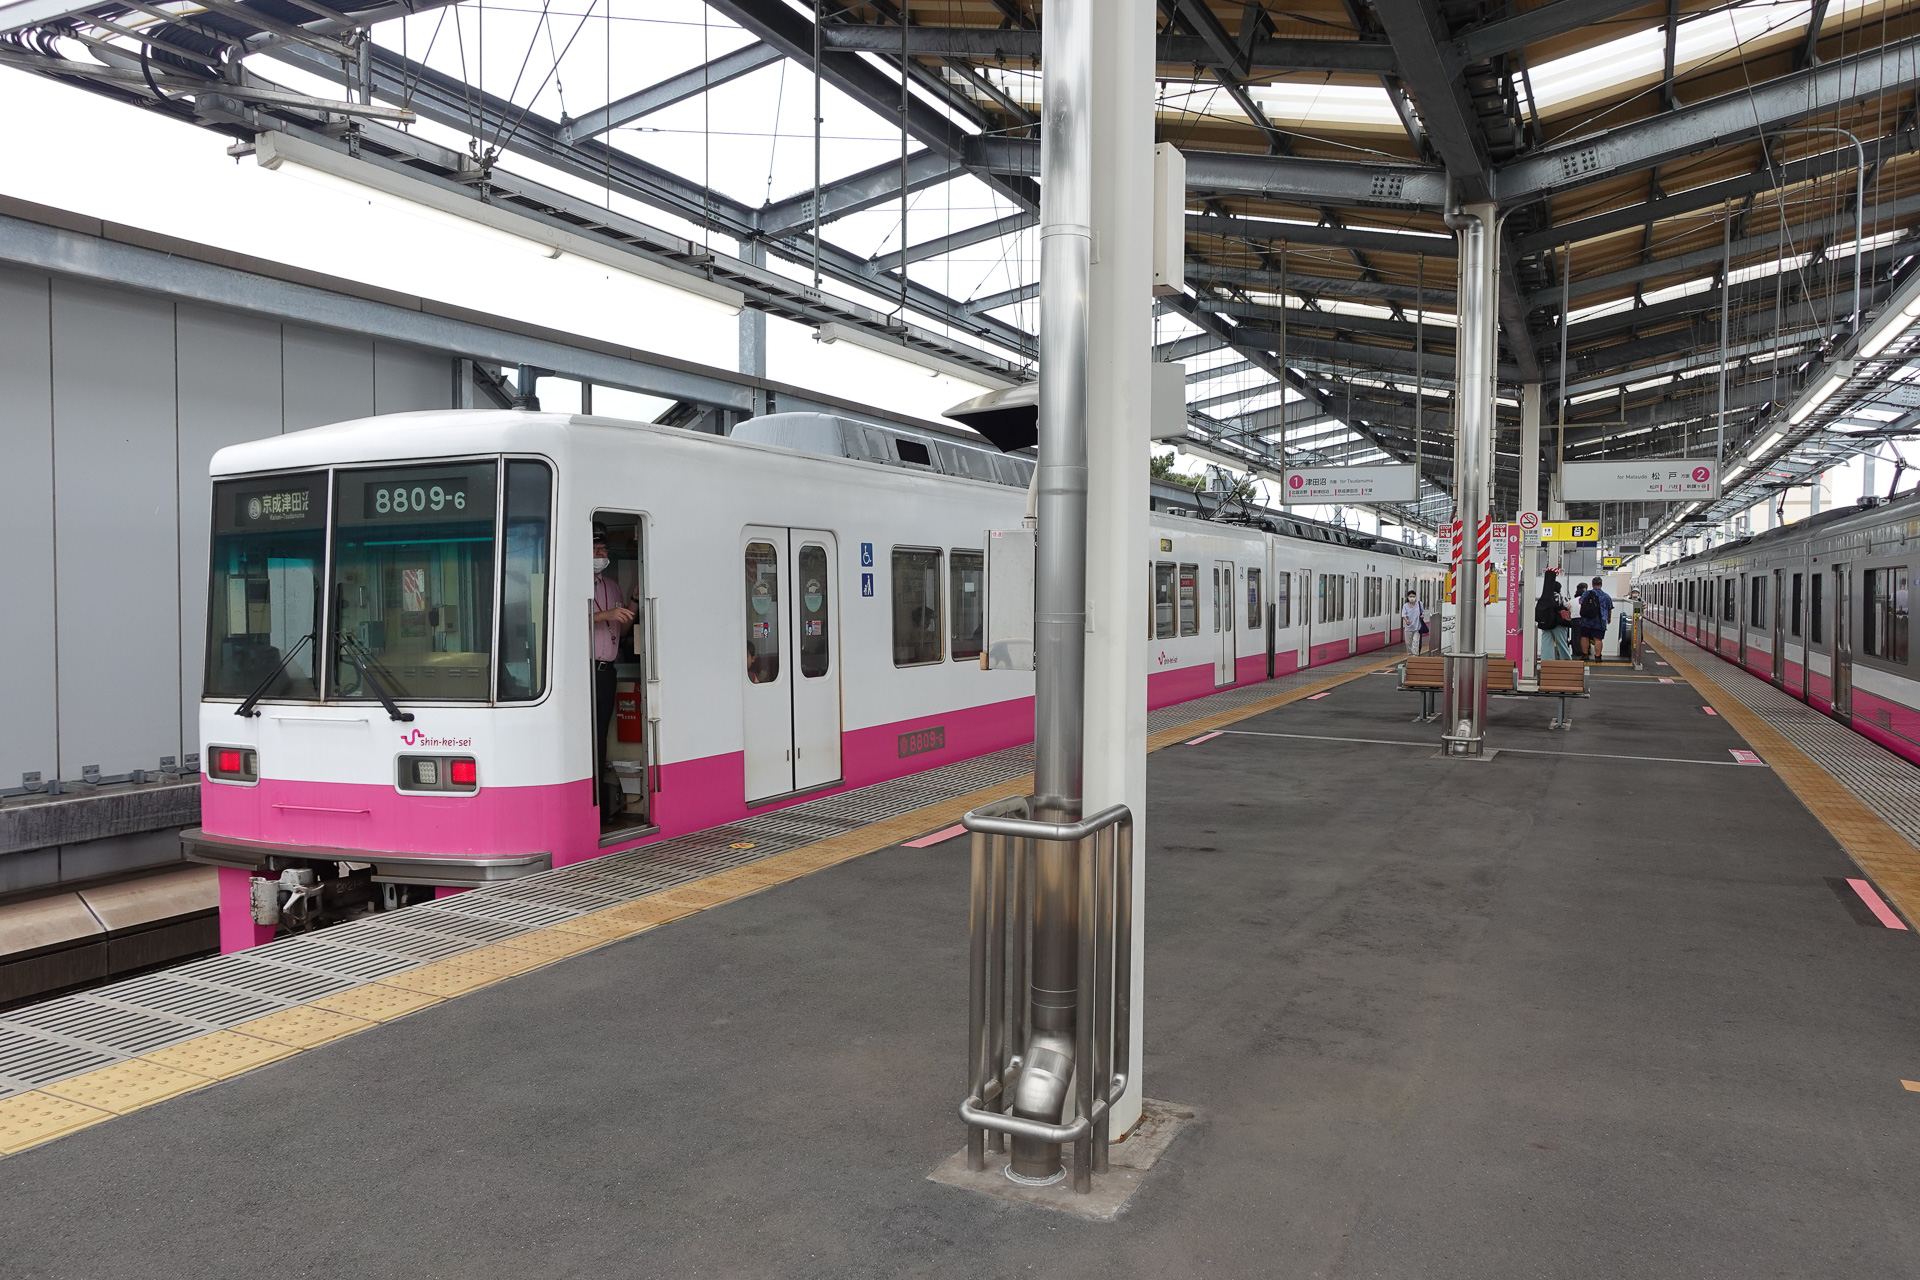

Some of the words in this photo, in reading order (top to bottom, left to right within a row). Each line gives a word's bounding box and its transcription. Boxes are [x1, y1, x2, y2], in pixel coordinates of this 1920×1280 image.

[1305, 478, 1326, 486] 津田沼
[375, 486, 465, 513] 8809-6
[420, 737, 472, 747] shin-kei-sei
[909, 730, 944, 752] 8809-6
